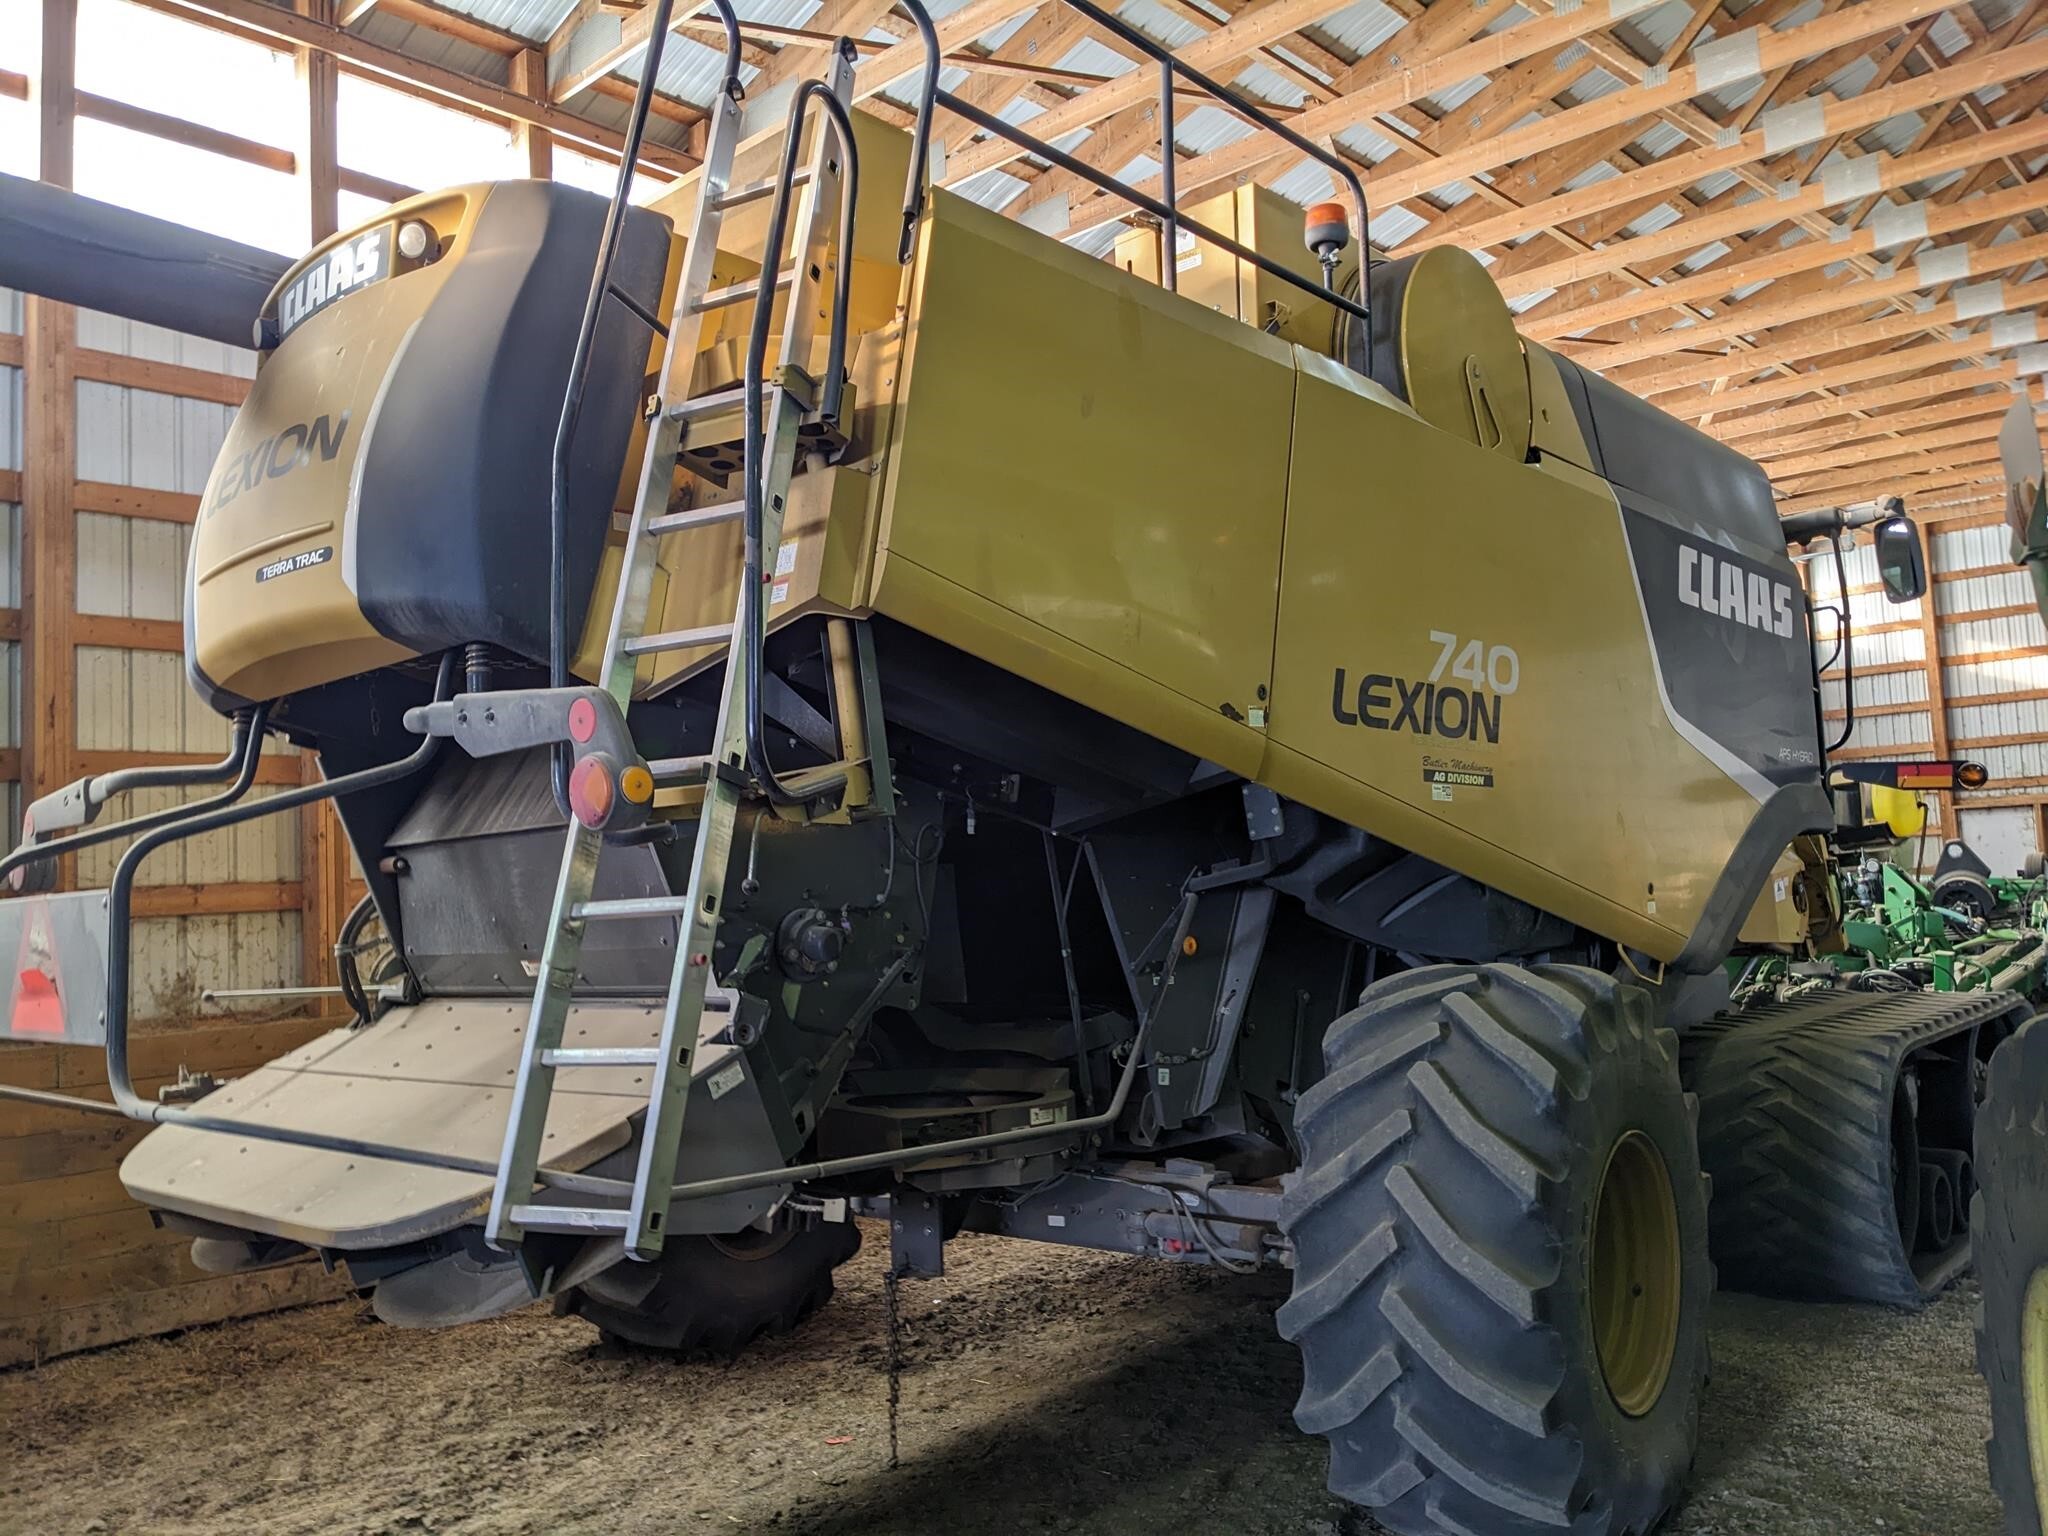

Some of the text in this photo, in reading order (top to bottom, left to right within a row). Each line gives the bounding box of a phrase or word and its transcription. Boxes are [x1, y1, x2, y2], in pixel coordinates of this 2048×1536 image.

[281, 231, 382, 334] CLAAS
[207, 410, 351, 519] LEXION
[262, 549, 325, 580] TERRA TRAC
[1678, 544, 1793, 639] CLAAS
[1427, 629, 1520, 696] 740
[1332, 667, 1502, 744] LEXION
[1422, 755, 1448, 769] Butler
[1433, 771, 1485, 785] AG DIVISION
